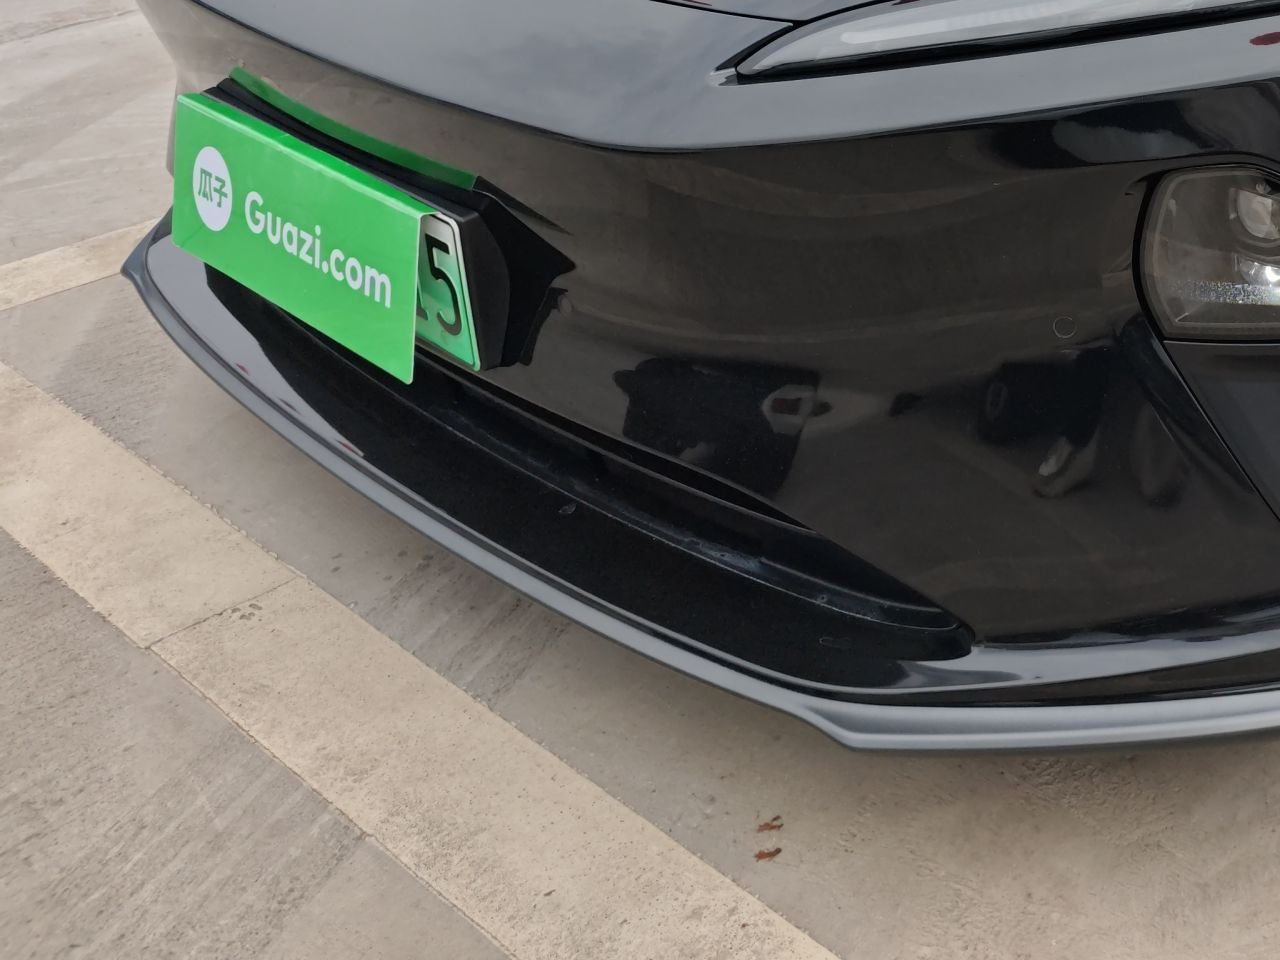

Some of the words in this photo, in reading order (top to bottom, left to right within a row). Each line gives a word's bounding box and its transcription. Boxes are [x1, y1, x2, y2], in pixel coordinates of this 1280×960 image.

[198, 168, 228, 208] 瓜子
[245, 191, 392, 309] Guazi.com
[416, 233, 462, 336] 5
